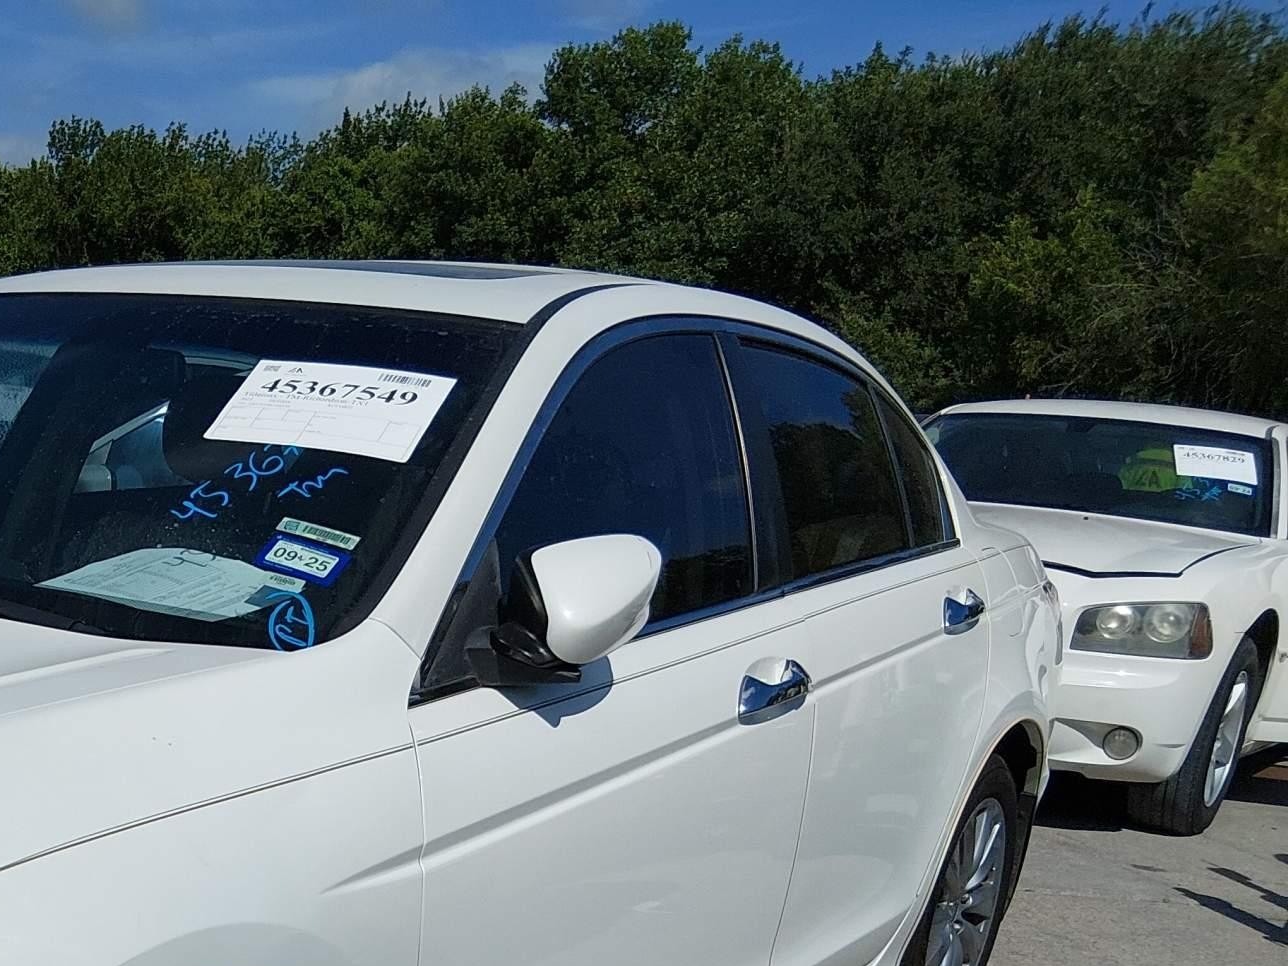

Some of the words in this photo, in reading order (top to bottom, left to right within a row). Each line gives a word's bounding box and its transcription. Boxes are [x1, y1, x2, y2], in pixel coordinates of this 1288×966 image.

[260, 377, 418, 406] 45367549
[273, 547, 298, 561] 09
[303, 556, 331, 572] 25
